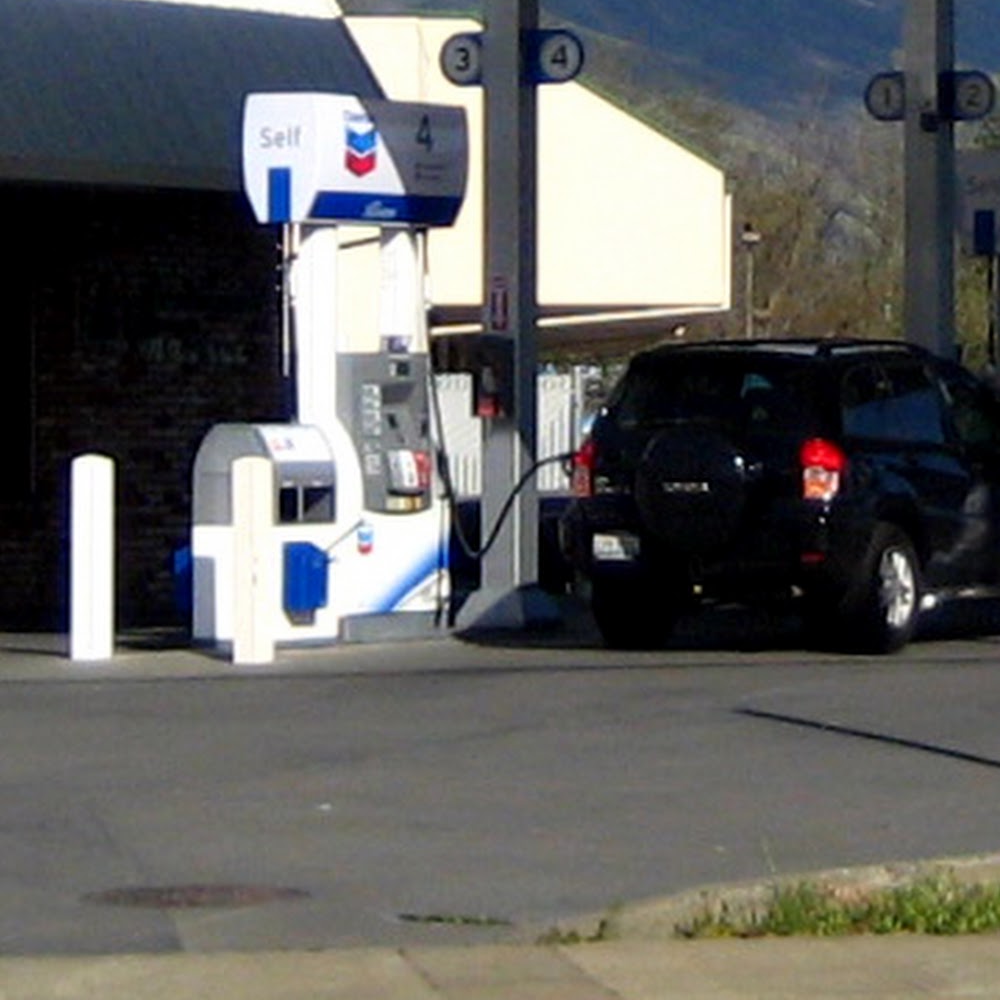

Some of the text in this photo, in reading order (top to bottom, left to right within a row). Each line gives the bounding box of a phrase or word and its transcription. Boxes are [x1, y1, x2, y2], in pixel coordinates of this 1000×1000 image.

[455, 47, 470, 71] 3
[551, 45, 567, 69] 4
[966, 85, 980, 107] 2
[258, 125, 302, 149] Self
[414, 114, 433, 151] 4
